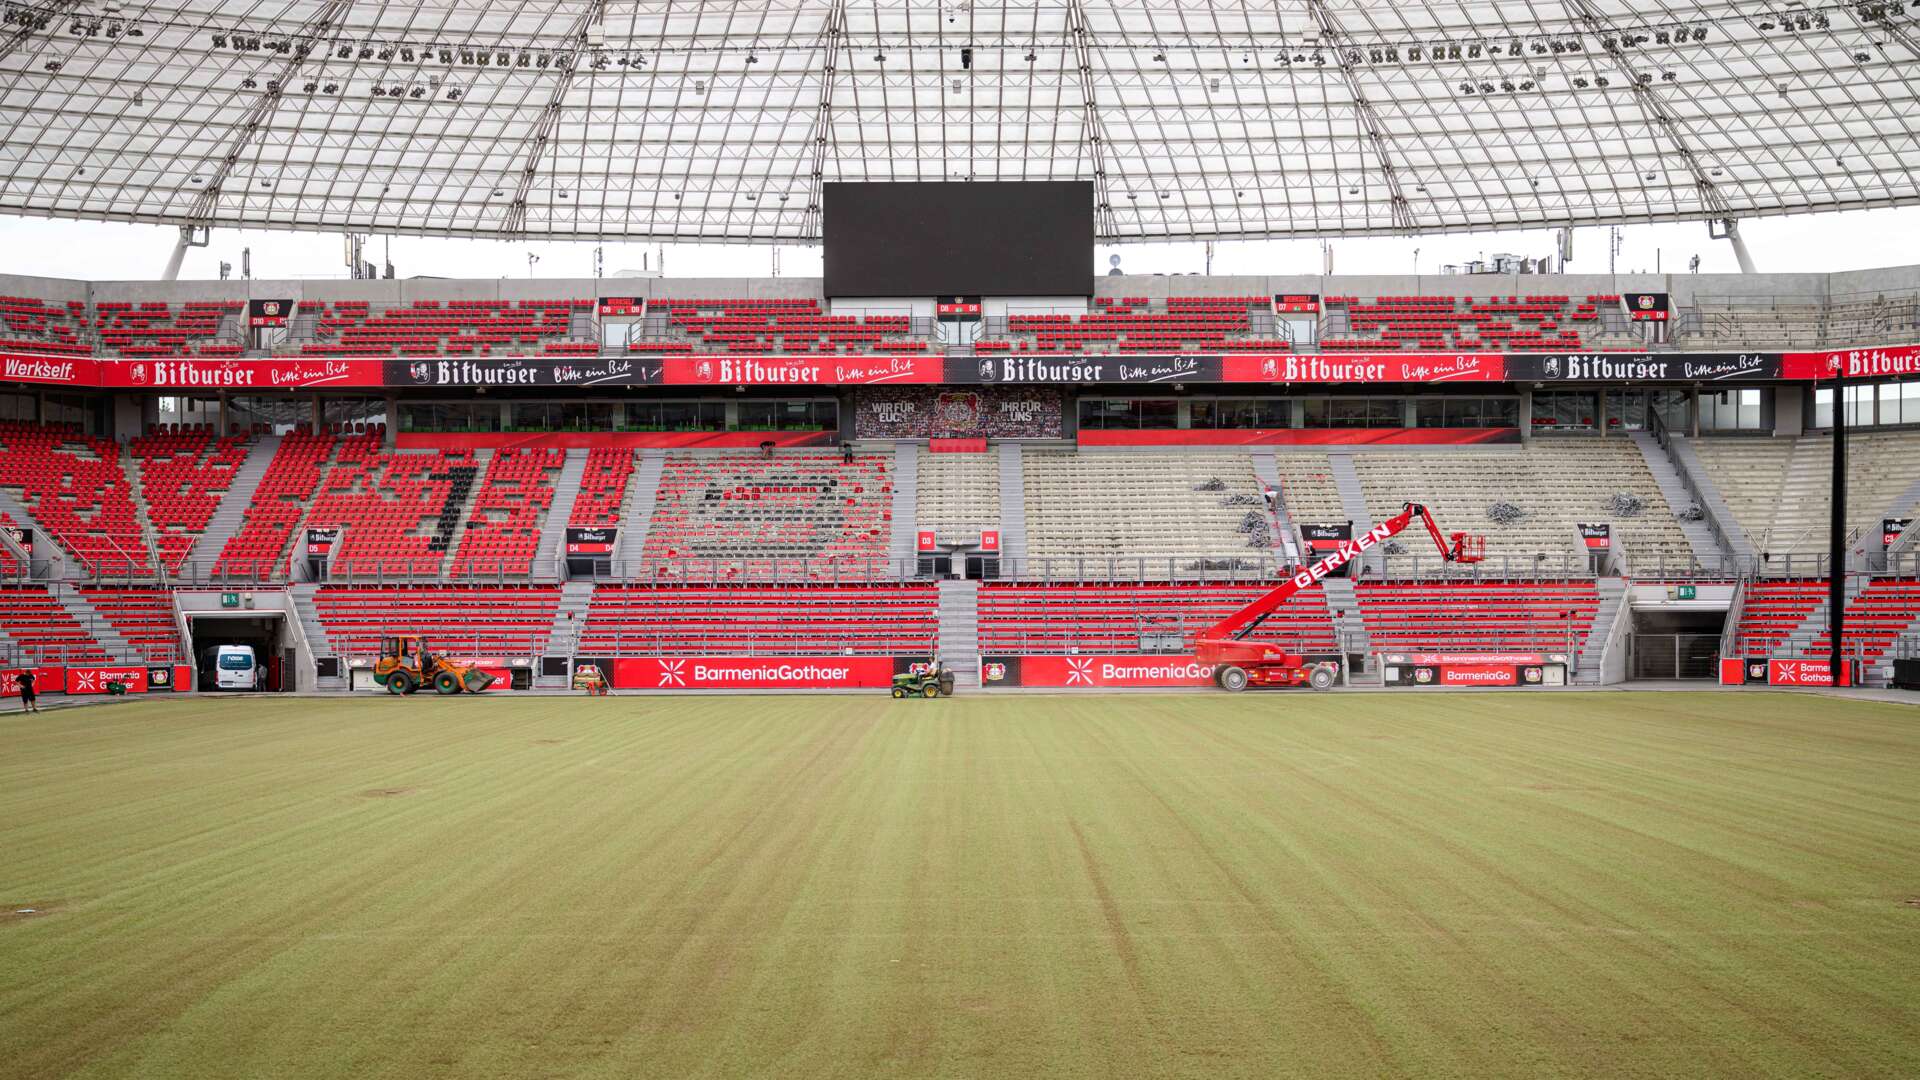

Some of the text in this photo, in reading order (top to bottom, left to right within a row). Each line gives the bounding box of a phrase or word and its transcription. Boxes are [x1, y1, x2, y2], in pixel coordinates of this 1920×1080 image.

[5, 358, 76, 381] Werkself.
[154, 362, 254, 385] Bitburger
[271, 361, 350, 384] Bitte ein Bit
[436, 361, 538, 384] Bitburger
[585, 369, 606, 378] ein
[608, 360, 632, 373] Bit
[719, 359, 820, 383] Bitburger
[836, 359, 914, 382] Bitte ein Bit
[1001, 358, 1103, 381] Bitburger
[1119, 357, 1198, 381] Bitte ein Bit
[1284, 357, 1386, 381] Bitburger
[1402, 355, 1480, 379] Bitte ein Bit
[1565, 355, 1668, 379] Bitburger
[1684, 355, 1763, 377] Bitte ein Bit
[1849, 350, 1920, 375] Bitburg
[872, 400, 915, 413] WIR FÜR
[1001, 399, 1041, 411] IHR FÜR
[1010, 412, 1032, 422] UNS
[308, 544, 318, 552] D5
[1600, 538, 1608, 547] D1
[1294, 522, 1391, 589] GERKEN
[694, 665, 850, 681] BarmeniaGothaer
[1102, 663, 1216, 679] BarmeniaGot
[1447, 671, 1511, 681] BarmeniaGo
